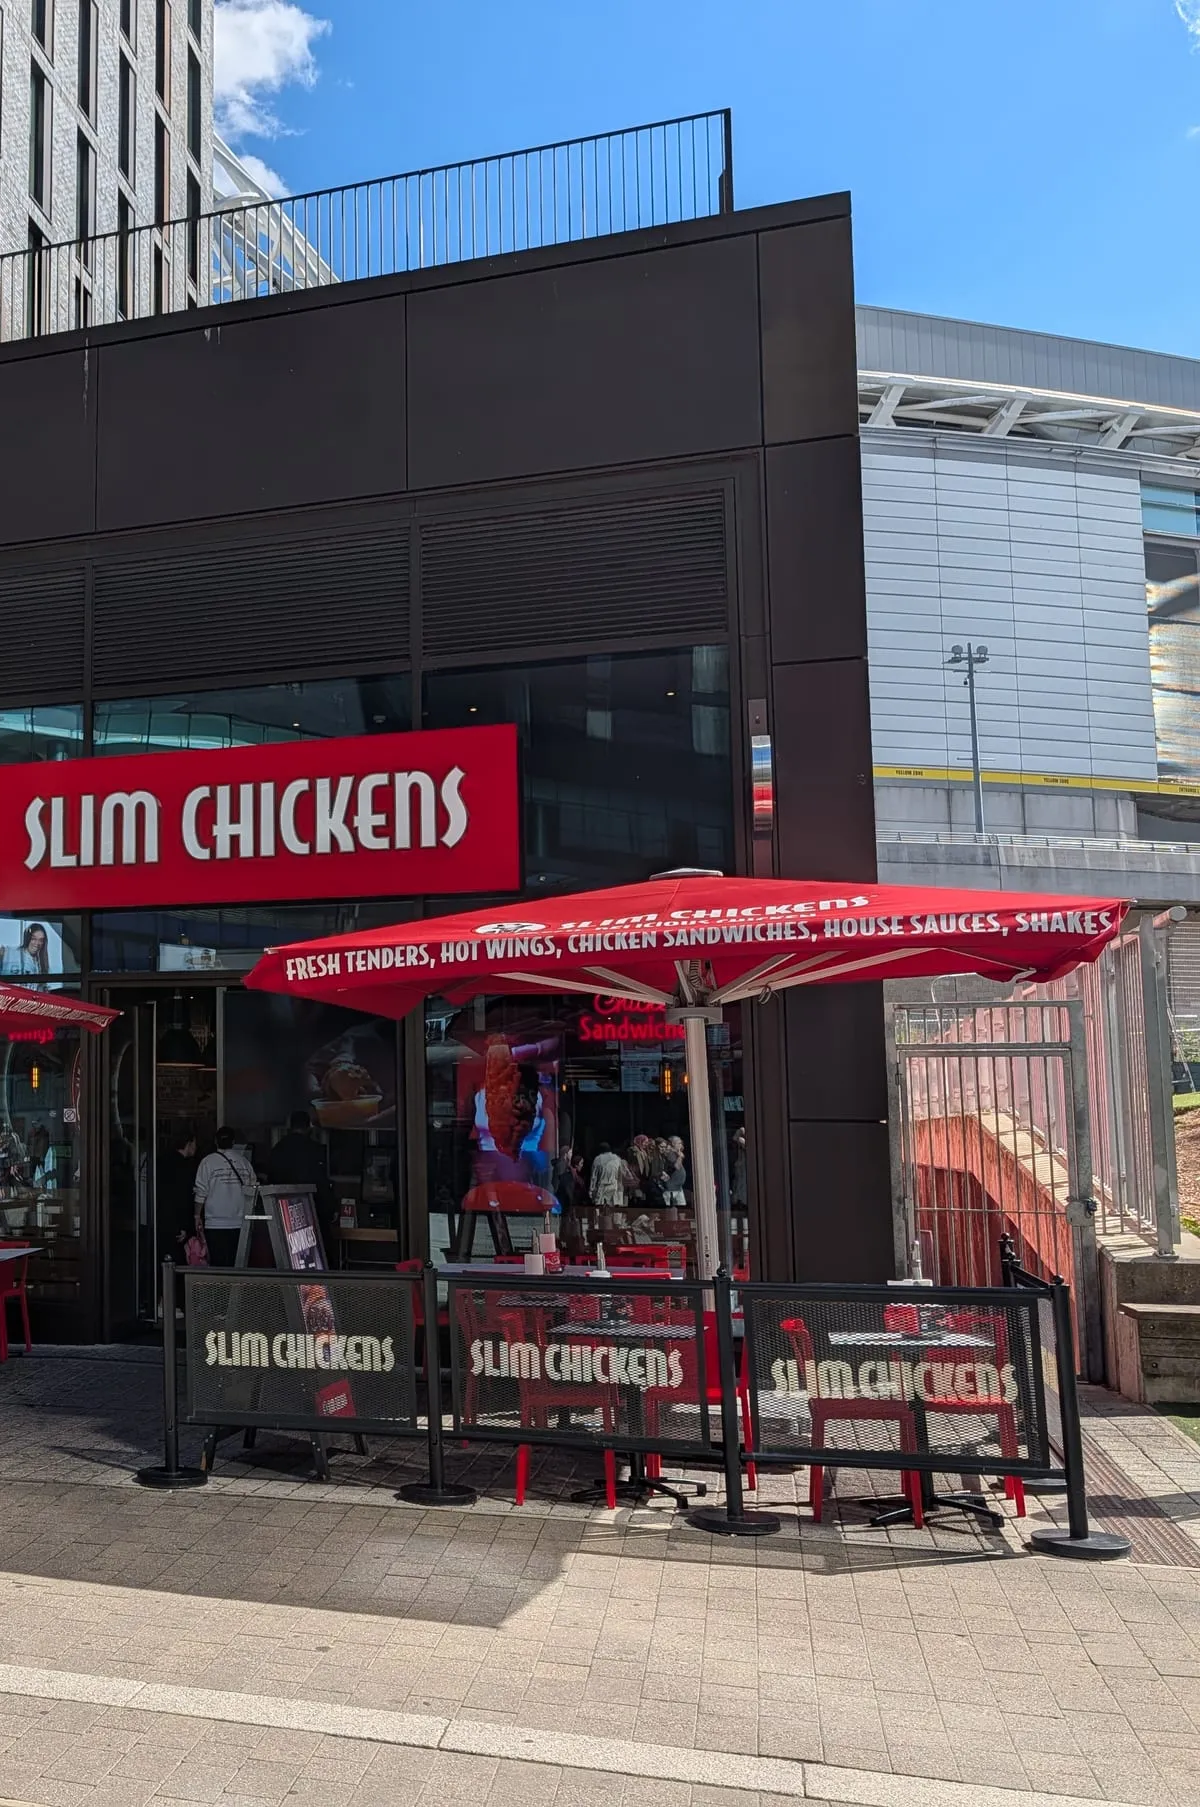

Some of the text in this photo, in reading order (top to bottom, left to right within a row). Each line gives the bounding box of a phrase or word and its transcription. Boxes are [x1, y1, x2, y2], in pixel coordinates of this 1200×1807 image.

[23, 765, 470, 871] SLIM CHICKENS
[670, 895, 870, 920] CHICKENS
[286, 911, 1113, 981] FRESH TENDERS, HOT WINGS, CHICKEN SANDWICHES, HOUSE SAUCES, SHAKES
[204, 1330, 395, 1372] SLIM CHICKENS
[470, 1338, 684, 1389] SLIM CHICKENS
[770, 1358, 1019, 1404] SLIM CHICKENS
